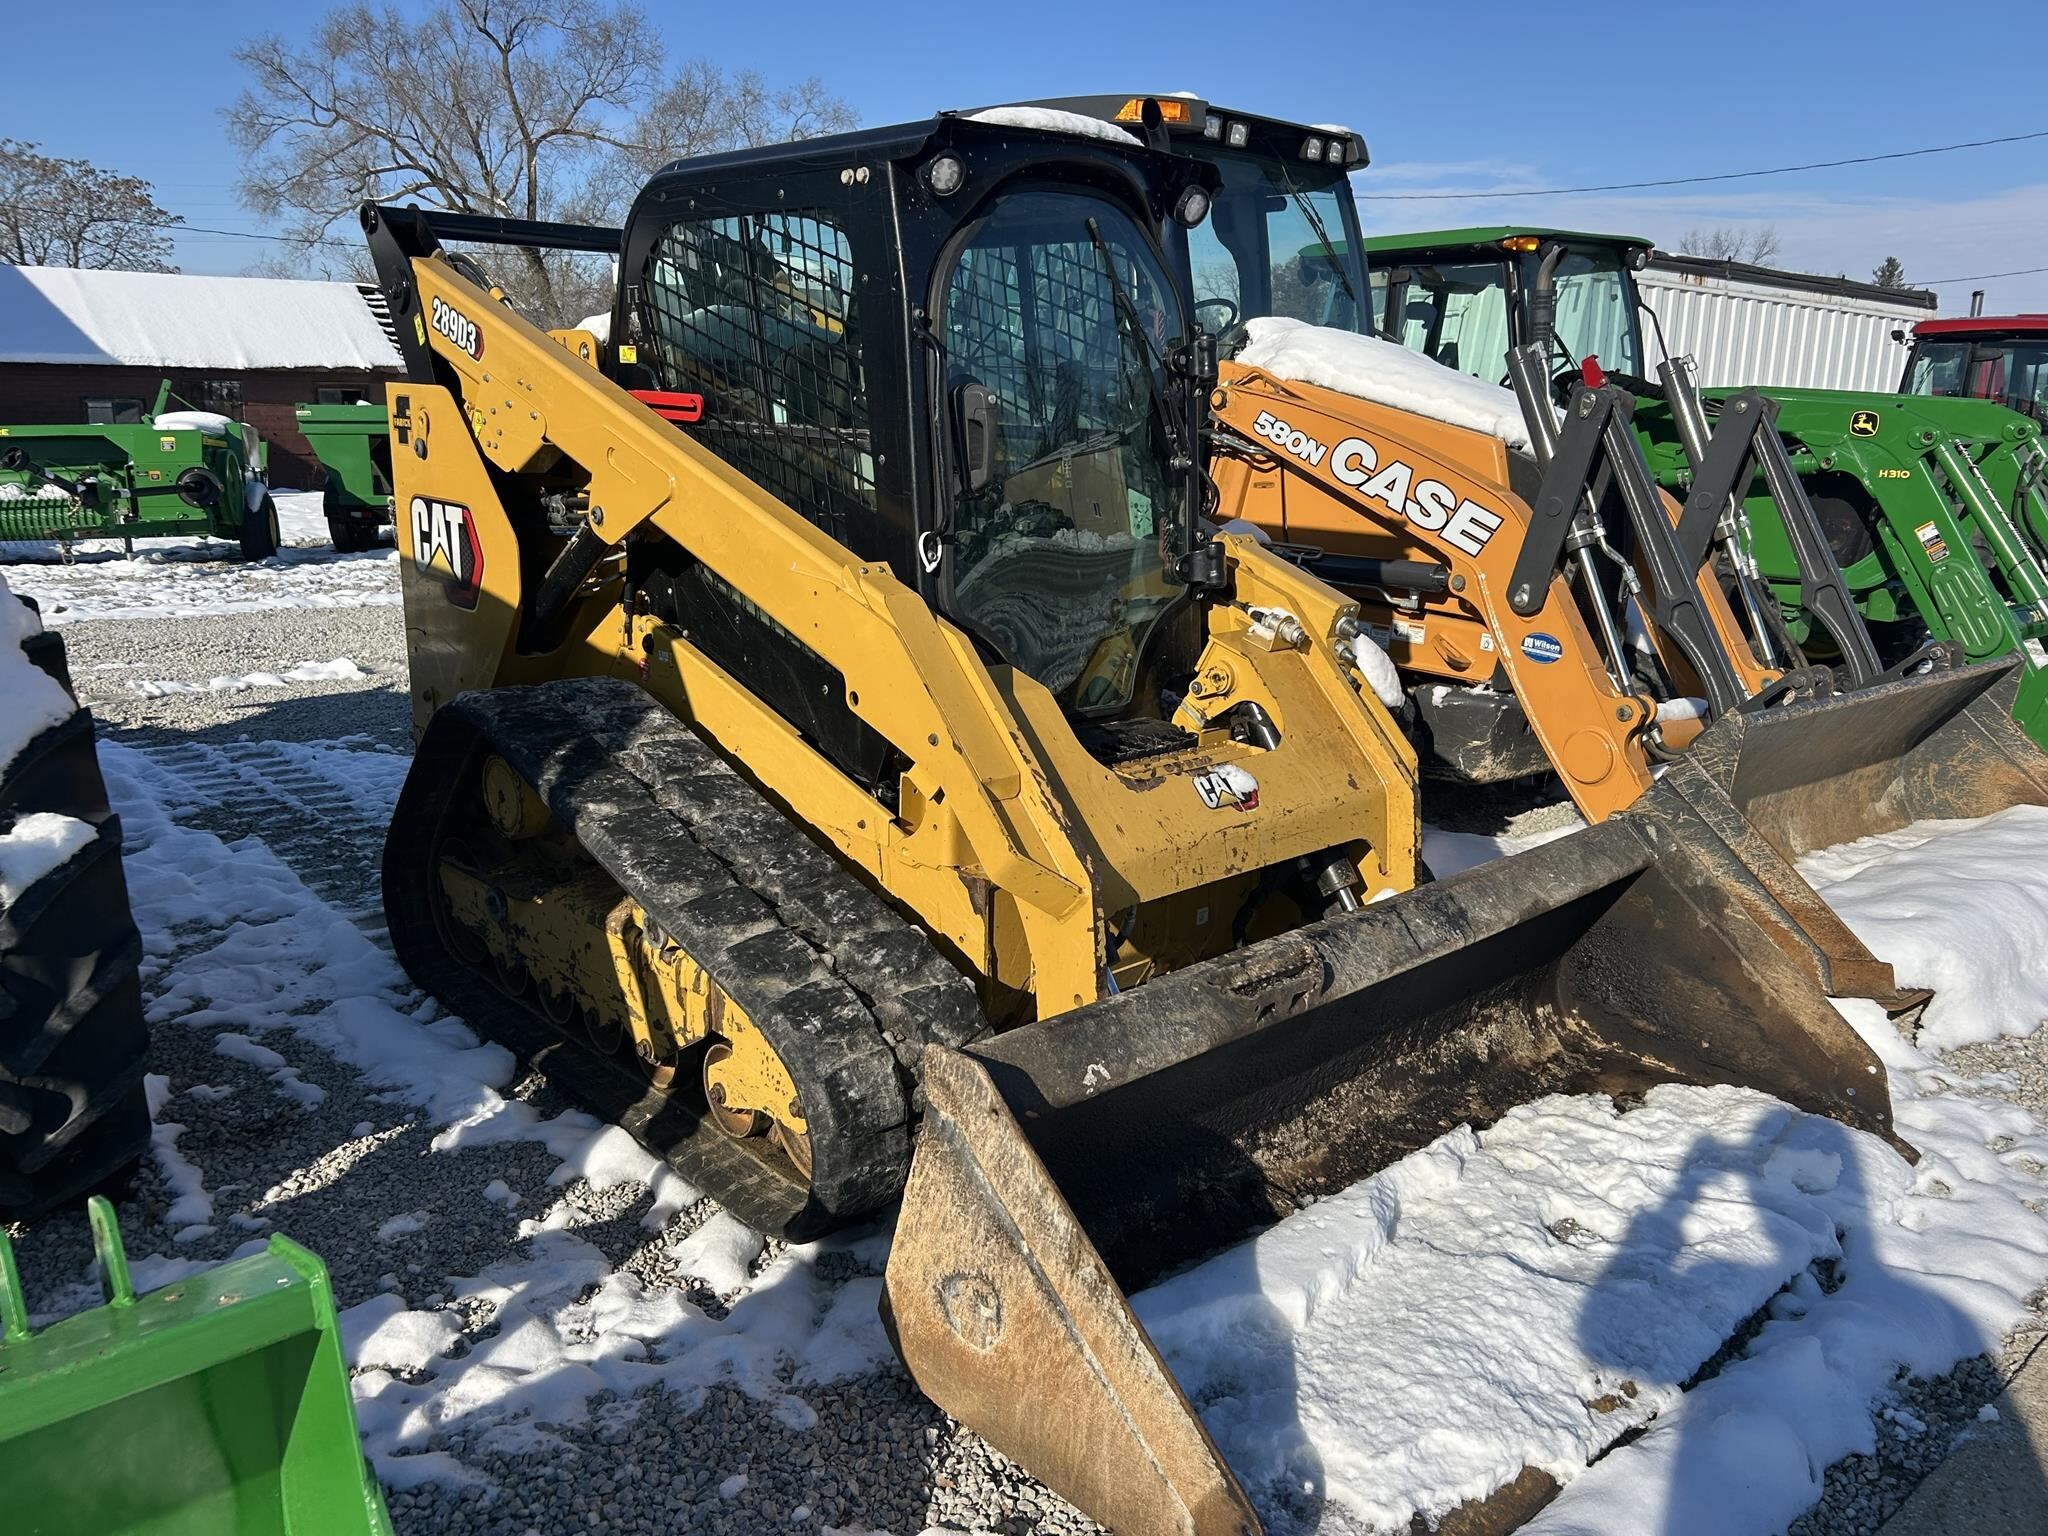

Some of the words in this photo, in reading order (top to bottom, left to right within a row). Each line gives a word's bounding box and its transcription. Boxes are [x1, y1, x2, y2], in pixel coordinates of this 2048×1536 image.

[432, 295, 477, 356] 289D3
[1253, 410, 1328, 467] 580N
[1330, 437, 1504, 558] CASE
[1879, 469, 1910, 479] H310
[411, 497, 464, 582] CAT
[1534, 638, 1561, 652] Wilson
